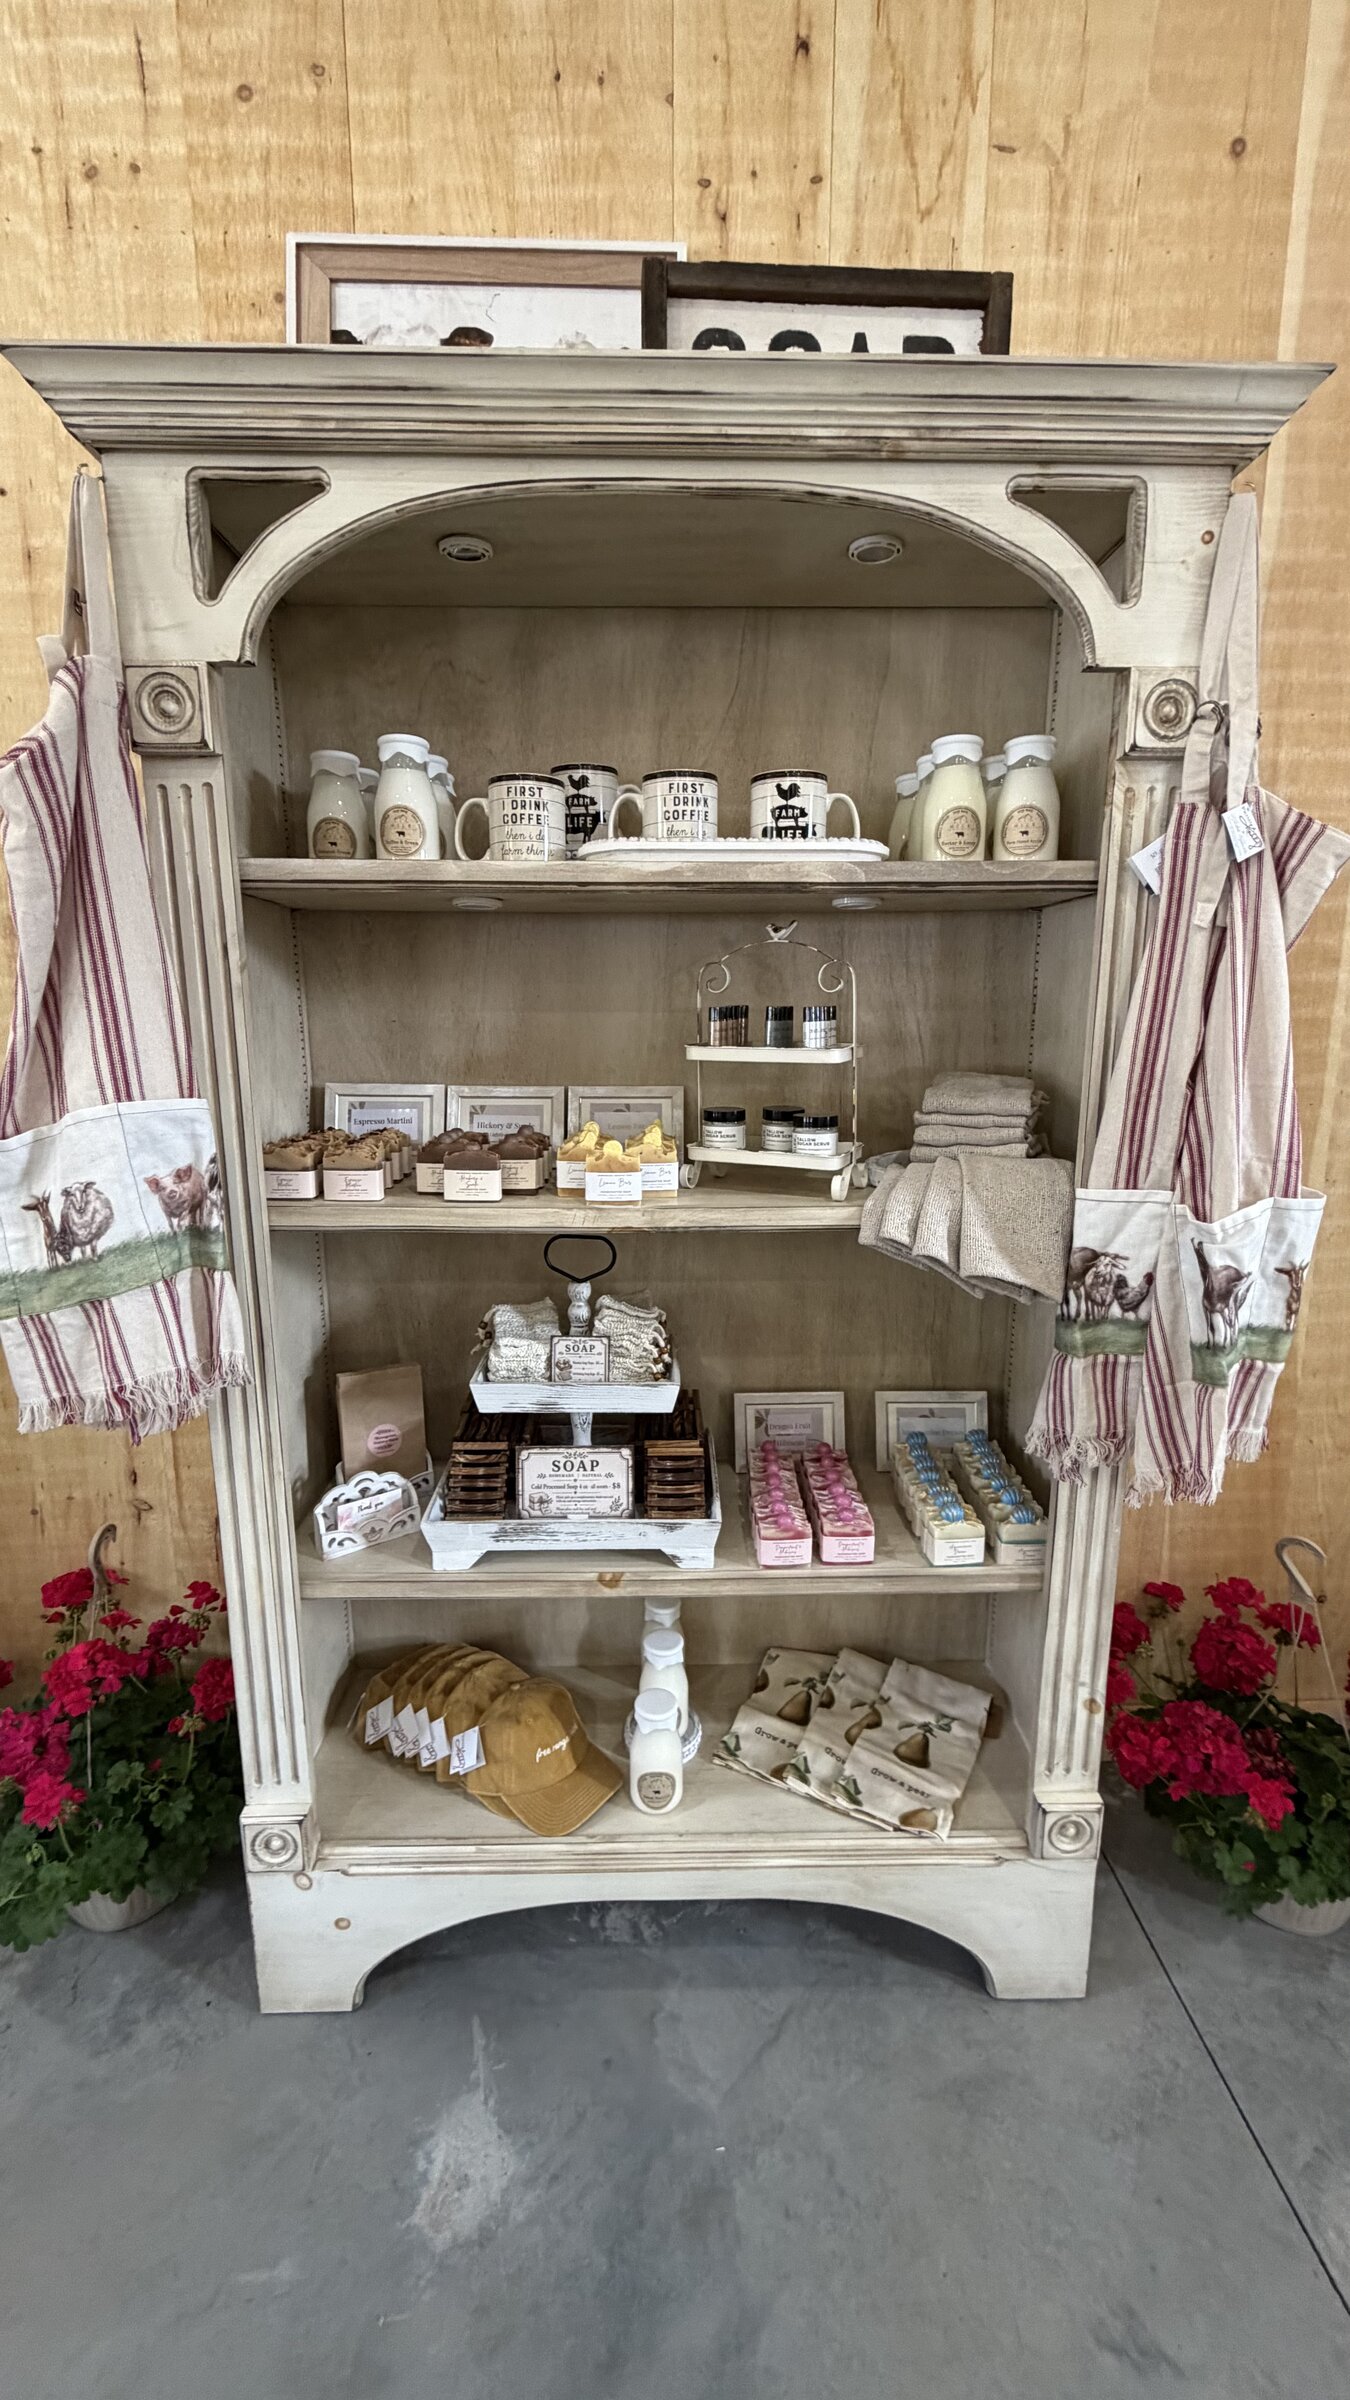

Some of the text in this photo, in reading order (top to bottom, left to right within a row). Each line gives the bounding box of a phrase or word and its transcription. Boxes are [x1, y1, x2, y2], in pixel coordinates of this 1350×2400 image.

[507, 786, 543, 798] FIRST
[668, 782, 705, 794] FIRST
[511, 799, 549, 812] DRINK
[673, 796, 709, 808] DRINK
[503, 813, 549, 825] COFFEE
[664, 809, 709, 822] COFFEE
[775, 808, 800, 818] FARM
[566, 817, 593, 828] LIFE
[506, 827, 526, 839] then
[667, 824, 688, 836] then
[526, 844, 555, 858] thins
[353, 1117, 413, 1126] Espresso Martini
[477, 1122, 504, 1130] Hickory
[564, 1344, 596, 1353] SOAP
[551, 1459, 600, 1472] SOAP
[612, 1482, 621, 1490] $8
[754, 1726, 780, 1742] Grow
[535, 1747, 552, 1764] free
[870, 1767, 896, 1783] Grow
[905, 1784, 931, 1800] pear
